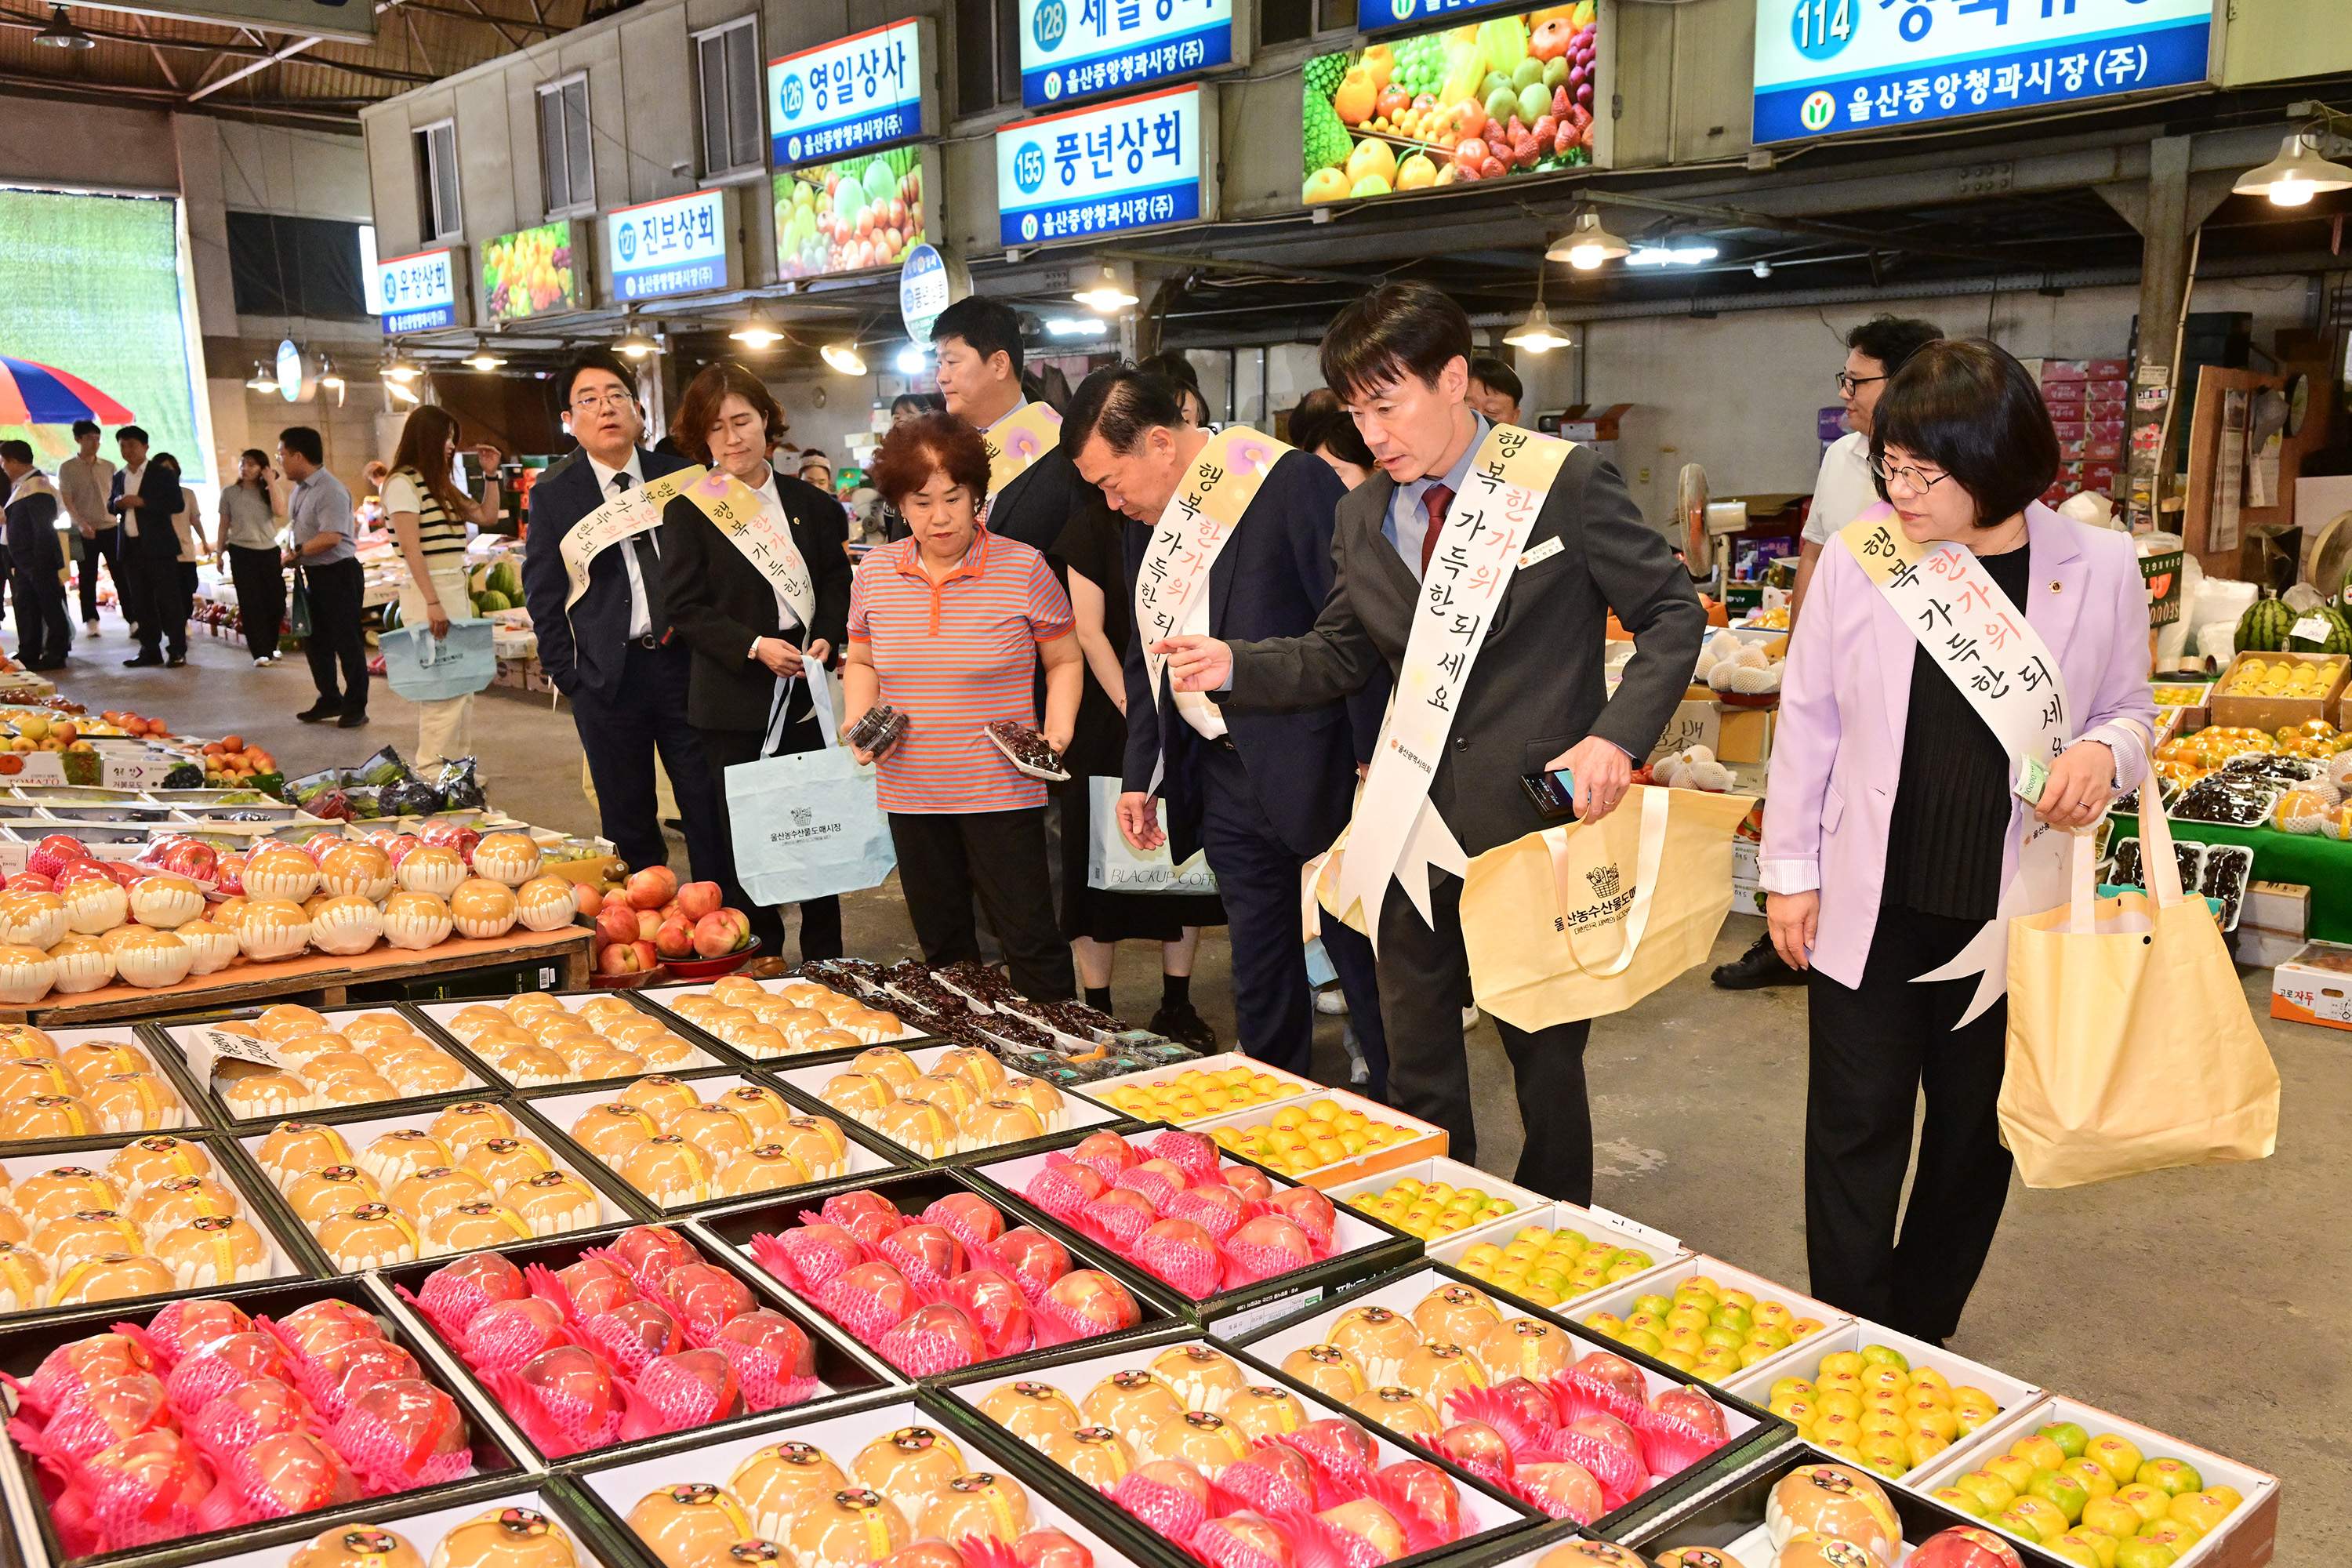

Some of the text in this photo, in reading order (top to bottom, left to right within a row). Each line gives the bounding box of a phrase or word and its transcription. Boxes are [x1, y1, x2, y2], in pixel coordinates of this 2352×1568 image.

[1036, 2, 1065, 42] 128
[1795, 0, 1851, 48] 114
[782, 41, 906, 113] 126 영일상사
[1066, 38, 1204, 94] 울산중앙청과시장(주)
[1846, 44, 2148, 122] 울산중앙청과시장(주)
[804, 113, 903, 156] 울산중앙청과시장(주)
[1017, 109, 1181, 187] 155 풍년상회
[620, 204, 715, 256] 127 진보상회
[1043, 194, 1174, 237] 울산중앙청과시장(주)
[400, 261, 447, 301] 유창상회
[577, 481, 677, 539] 행복 가득한
[601, 508, 660, 540] 한가위
[1142, 463, 1224, 610] 행복 가득한
[1429, 431, 1528, 617] 행복 가득한
[713, 501, 801, 597] 행복 가득한
[752, 514, 802, 571] 한가위
[1167, 520, 1221, 605] 한가위
[2140, 557, 2182, 572] ORANGE
[1426, 490, 1534, 713] 한가위 되세요
[1863, 526, 2009, 699] 행복 가득한
[1928, 549, 2021, 651] 한가위
[1398, 745, 1432, 775] 울산광역시의회
[2024, 775, 2037, 795] 10000
[771, 823, 841, 842] 울산농수산물도매시장
[1111, 869, 1175, 883] BLACKUP
[2294, 990, 2314, 1006] 자두
